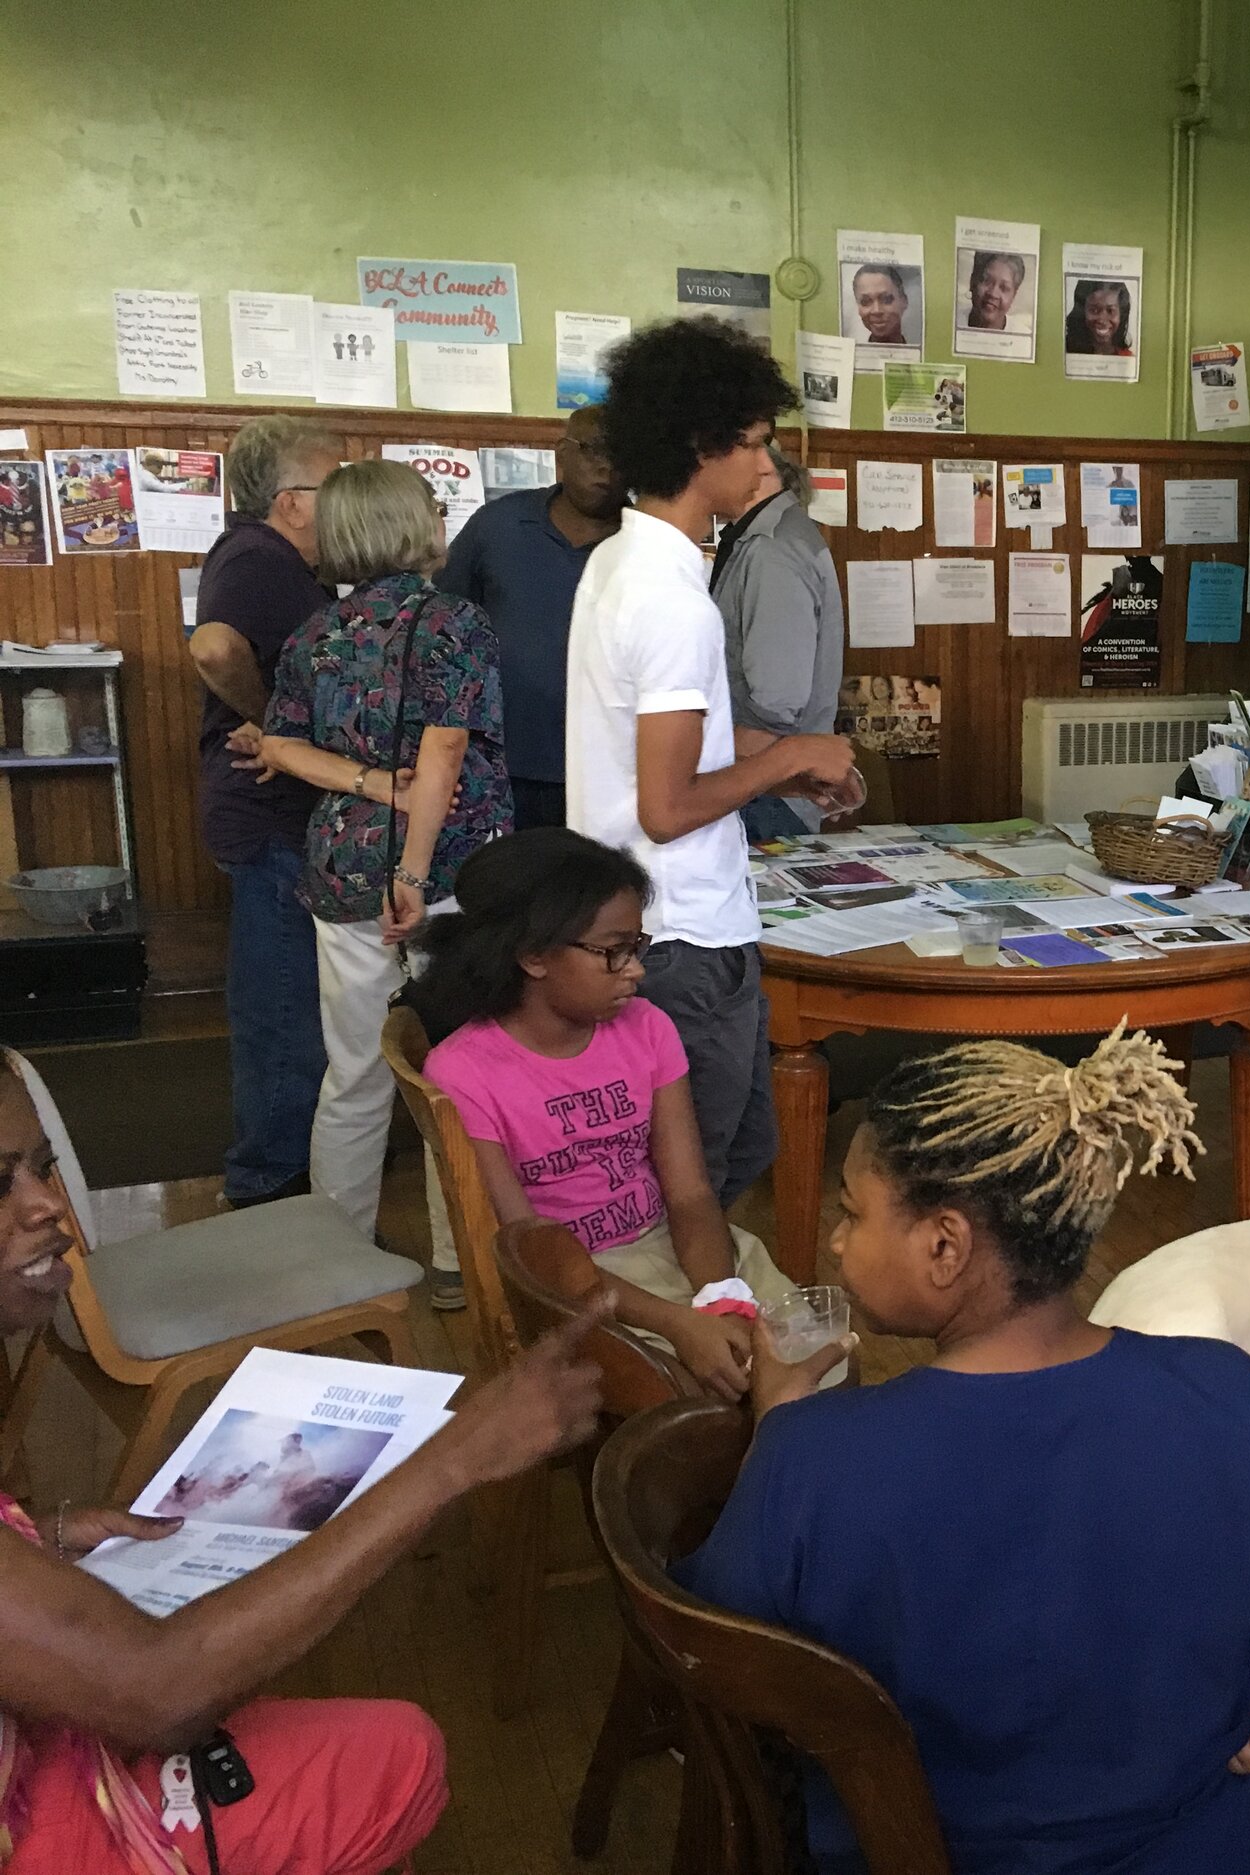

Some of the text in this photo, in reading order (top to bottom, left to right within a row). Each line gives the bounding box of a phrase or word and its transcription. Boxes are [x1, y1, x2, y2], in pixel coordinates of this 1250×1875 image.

[868, 246, 895, 255] healthy
[1071, 261, 1089, 269] know
[433, 272, 508, 297] Connects
[686, 284, 731, 299] VISION
[437, 345, 478, 356] Shelter list
[408, 448, 455, 457] SUMMER
[410, 458, 471, 480] OOD
[1112, 599, 1158, 610] HEROES
[545, 1079, 637, 1135] THE
[600, 1146, 637, 1192] IS
[562, 1180, 665, 1250] EMA
[323, 1385, 404, 1409] STOLEN LAND
[311, 1402, 406, 1428] STOLEN FUTURE
